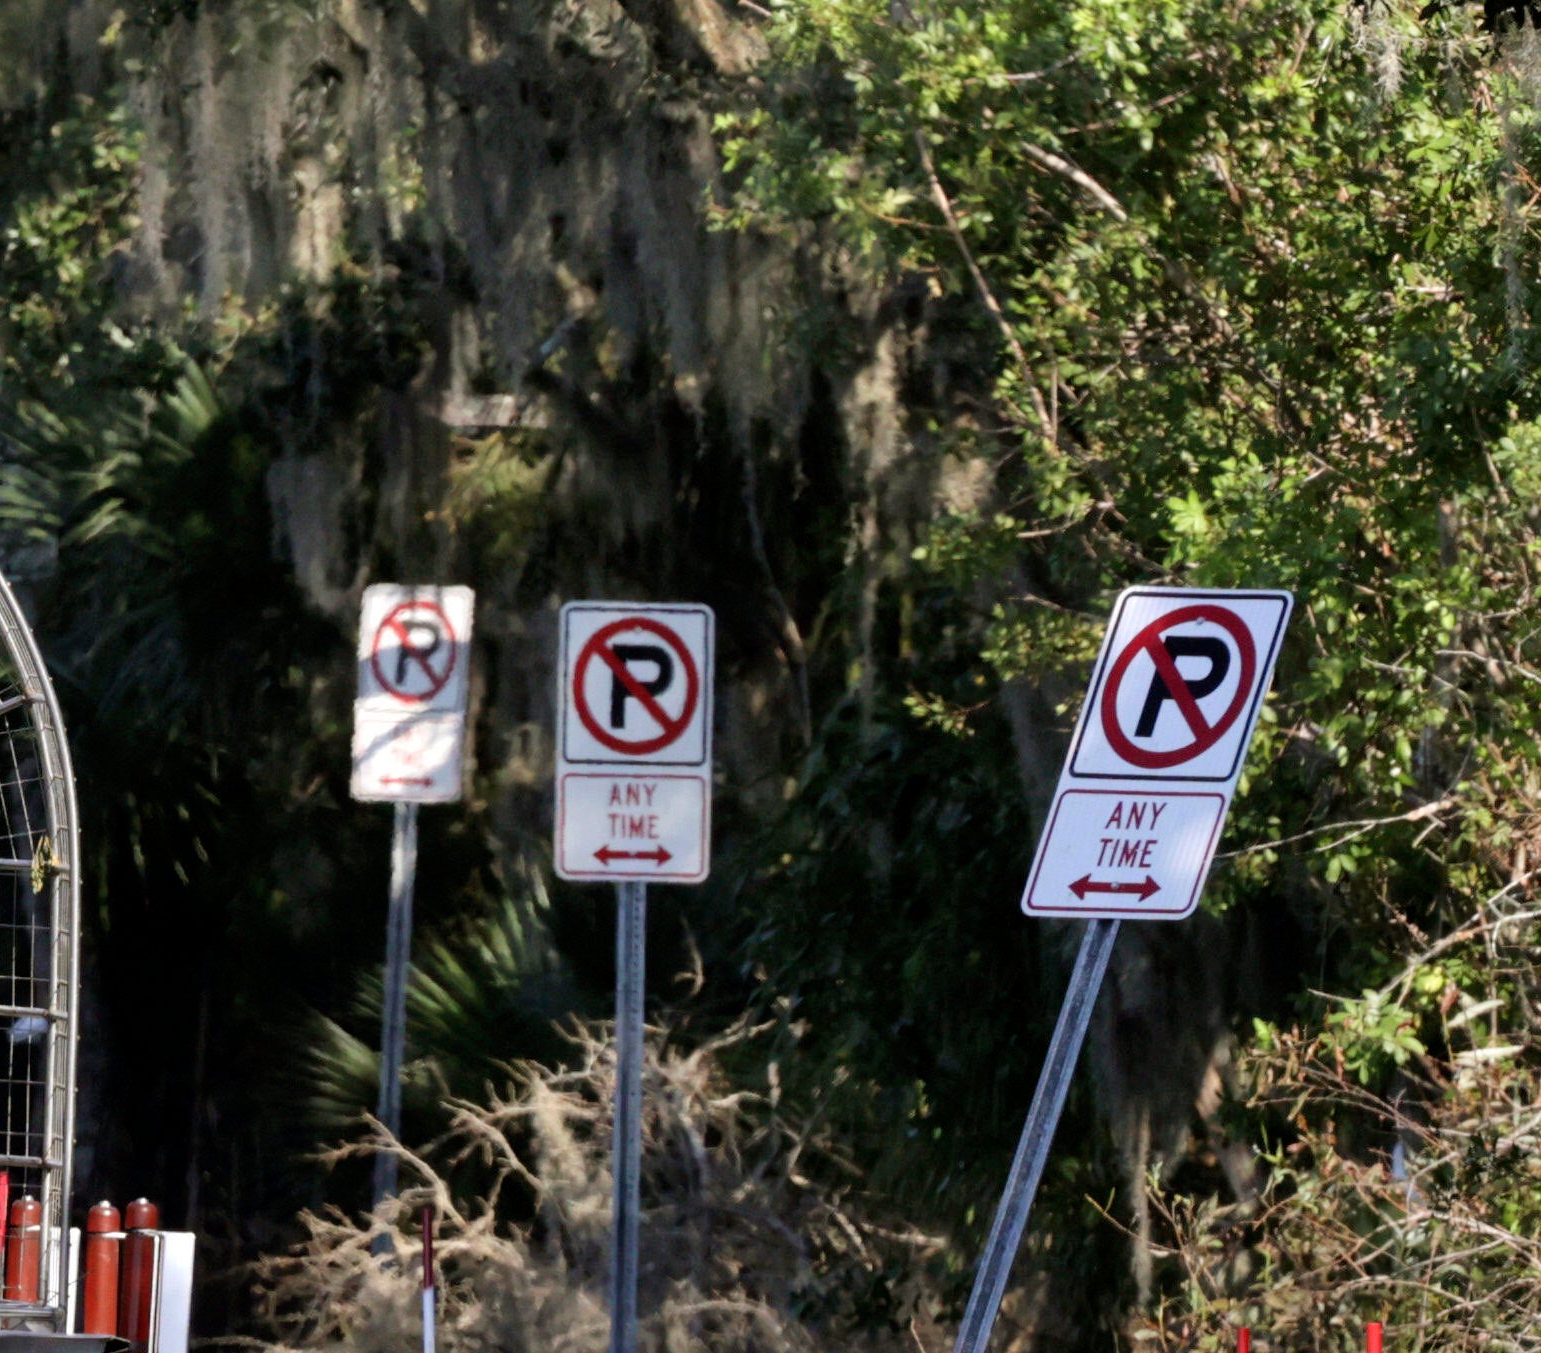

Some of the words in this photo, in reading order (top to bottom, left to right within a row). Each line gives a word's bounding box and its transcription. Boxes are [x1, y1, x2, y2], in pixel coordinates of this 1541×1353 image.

[394, 619, 440, 685] P
[610, 643, 675, 729] P
[1133, 635, 1231, 738] P
[608, 783, 658, 807] ANY
[607, 813, 661, 840] TIME
[1104, 801, 1168, 831] ANY
[1096, 838, 1158, 869] TIME
